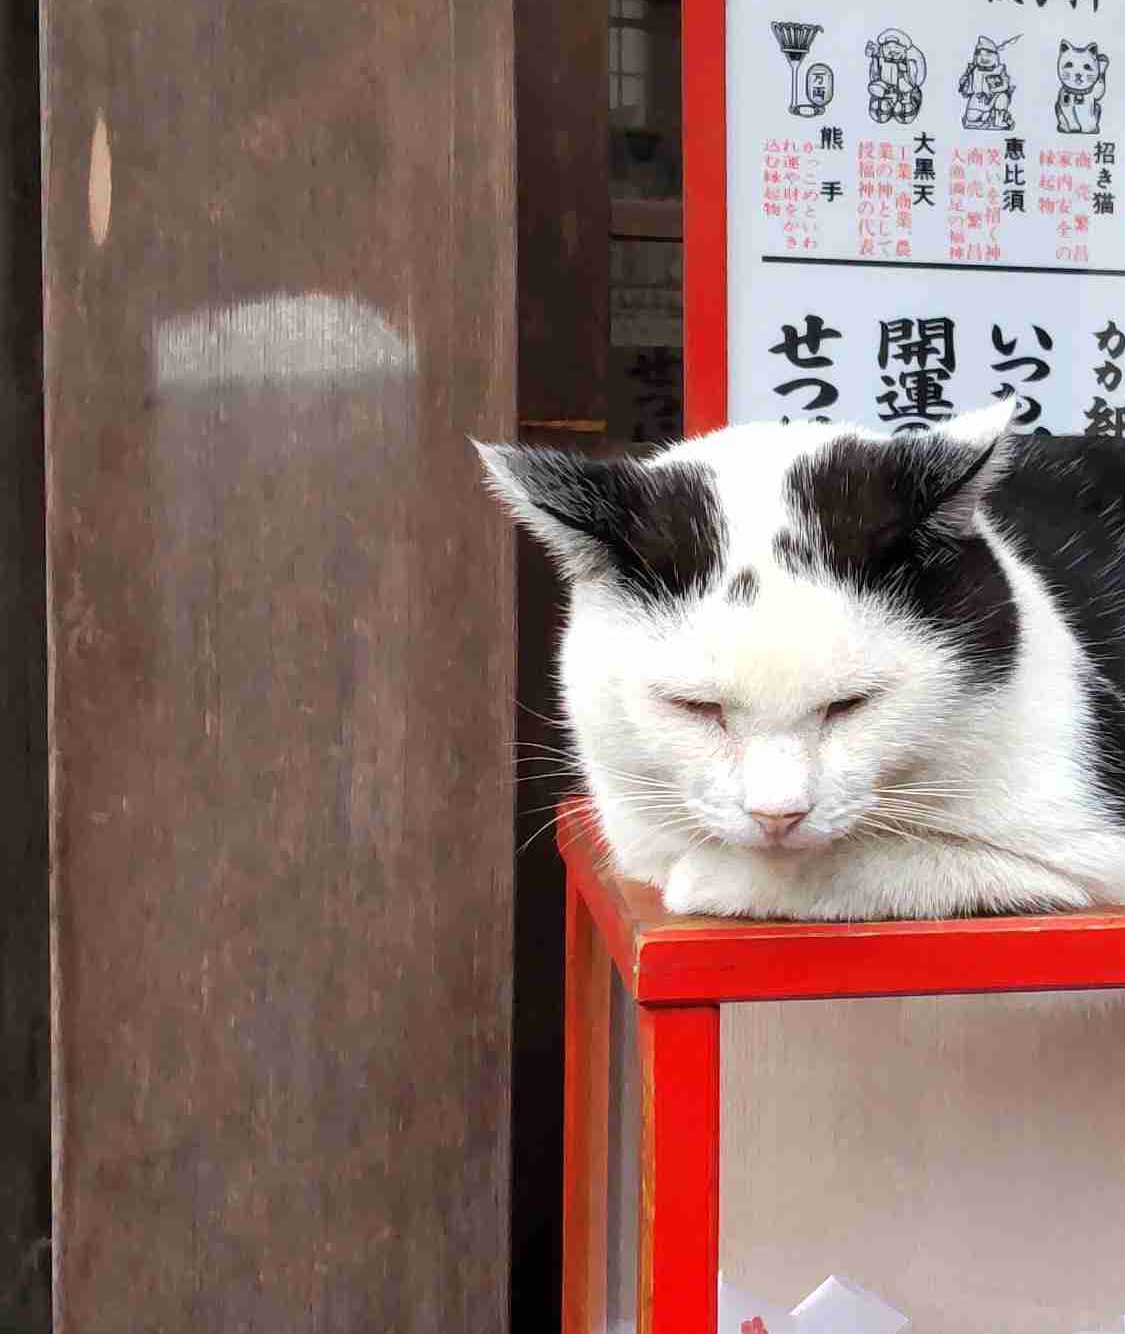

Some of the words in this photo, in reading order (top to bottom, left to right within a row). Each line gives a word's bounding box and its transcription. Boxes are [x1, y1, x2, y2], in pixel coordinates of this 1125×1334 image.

[820, 126, 844, 203] 熊手
[913, 131, 937, 207] 大黒天
[1002, 137, 1026, 214] 恵比須
[1092, 141, 1116, 215] 招き猫
[767, 314, 843, 425] せつ
[874, 316, 956, 436] 開運
